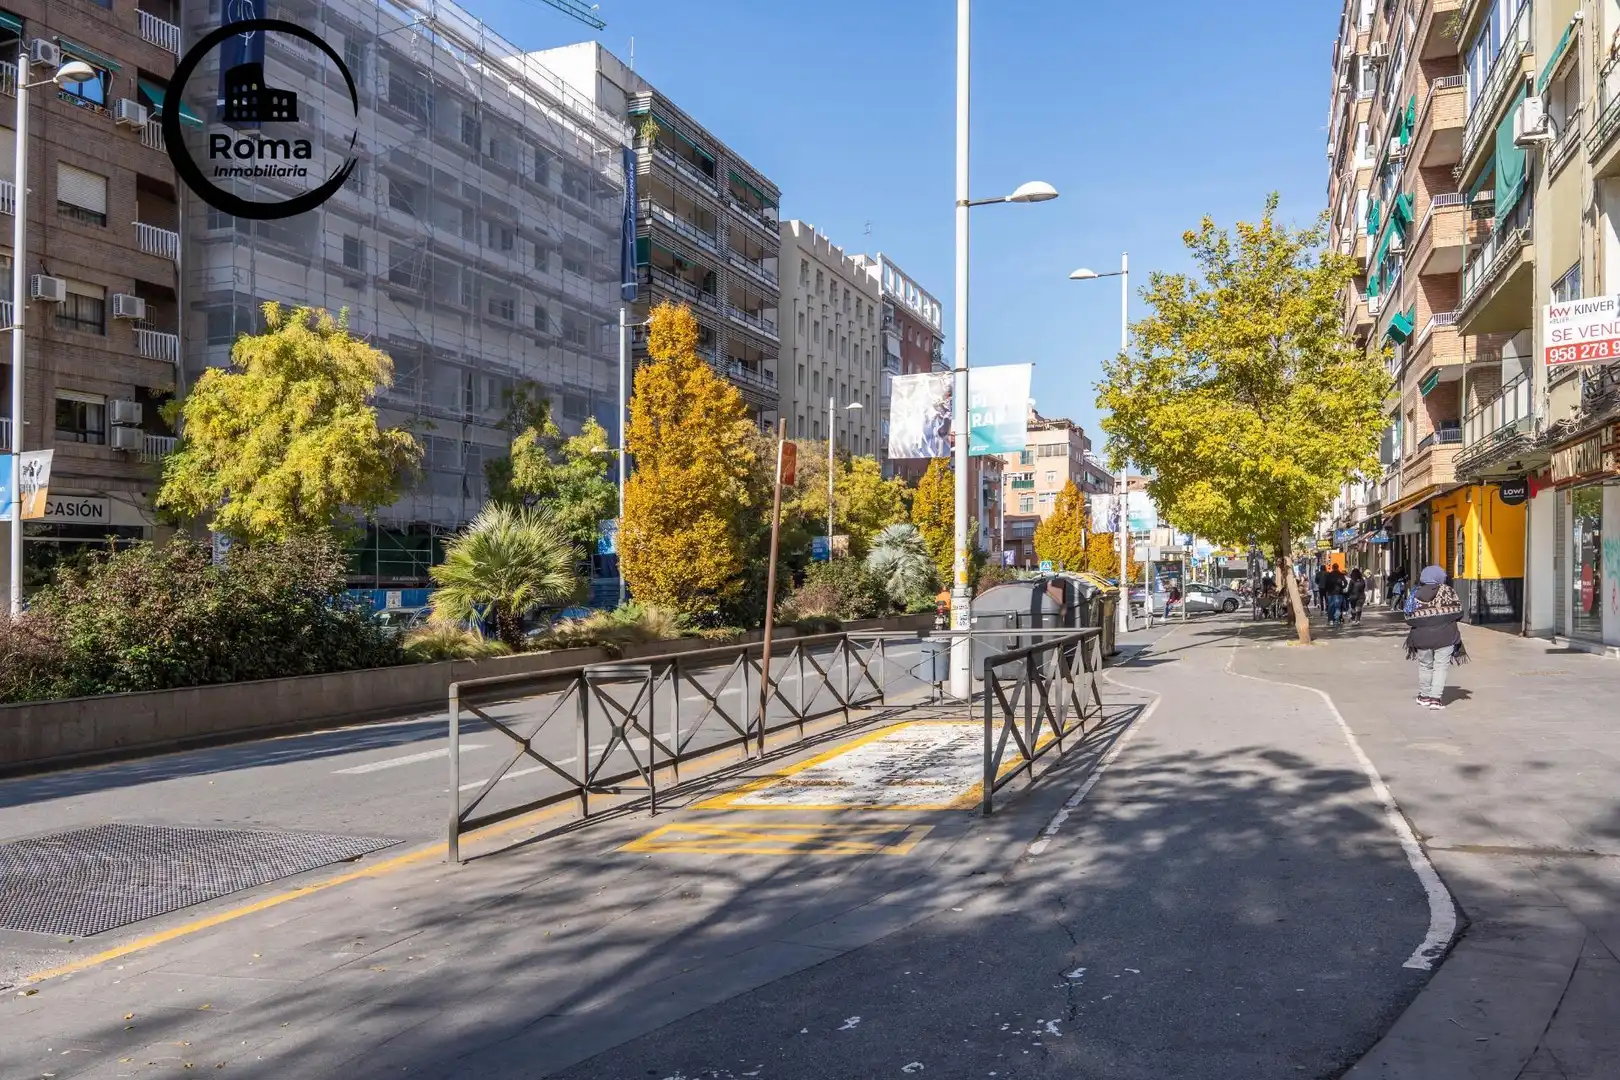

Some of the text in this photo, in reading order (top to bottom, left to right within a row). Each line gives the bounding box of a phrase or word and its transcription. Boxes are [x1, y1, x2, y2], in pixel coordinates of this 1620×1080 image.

[1574, 300, 1614, 315] KINVER
[1552, 328, 1573, 343] SE
[1550, 346, 1576, 363] 958
[1581, 342, 1608, 359] 278
